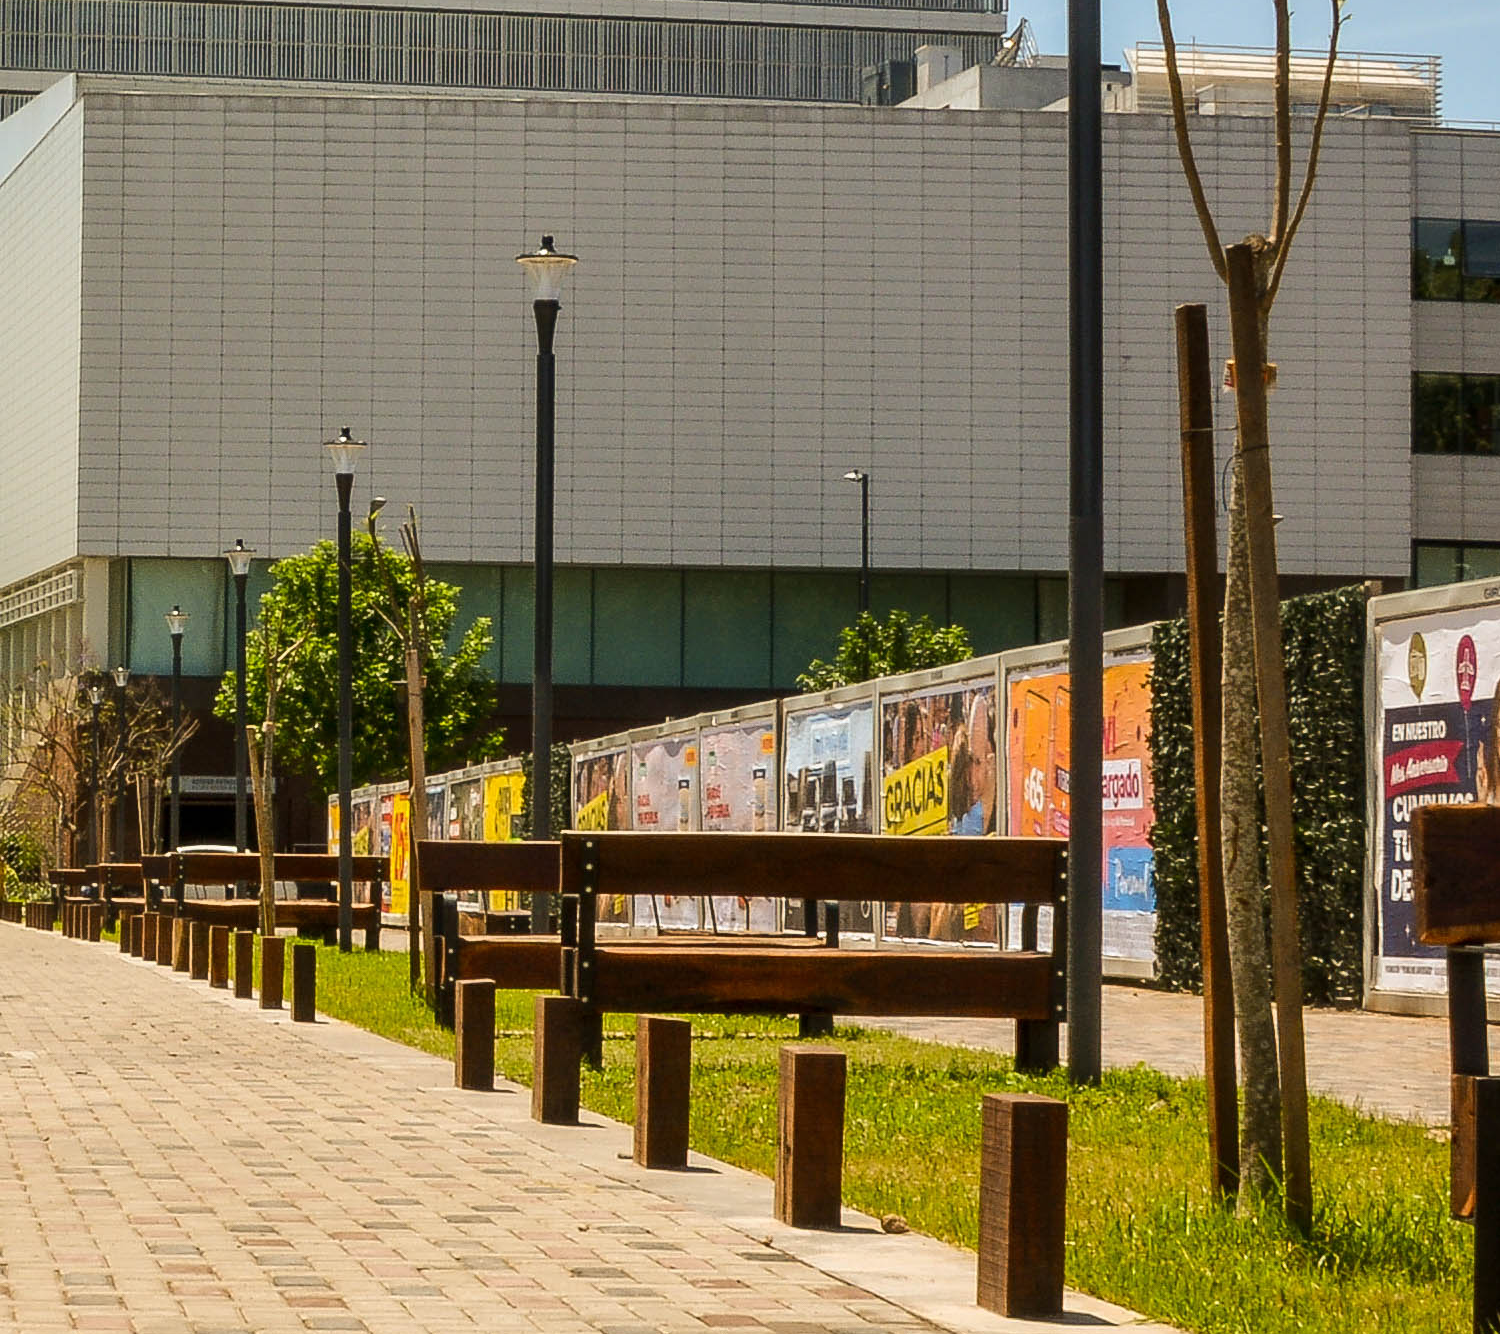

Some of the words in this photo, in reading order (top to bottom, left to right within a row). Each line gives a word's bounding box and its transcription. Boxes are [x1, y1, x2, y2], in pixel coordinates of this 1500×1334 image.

[1391, 722, 1405, 743] EN
[1405, 720, 1448, 741] NUESTRO
[884, 760, 945, 824] GRACIAS
[1102, 762, 1140, 809] argado
